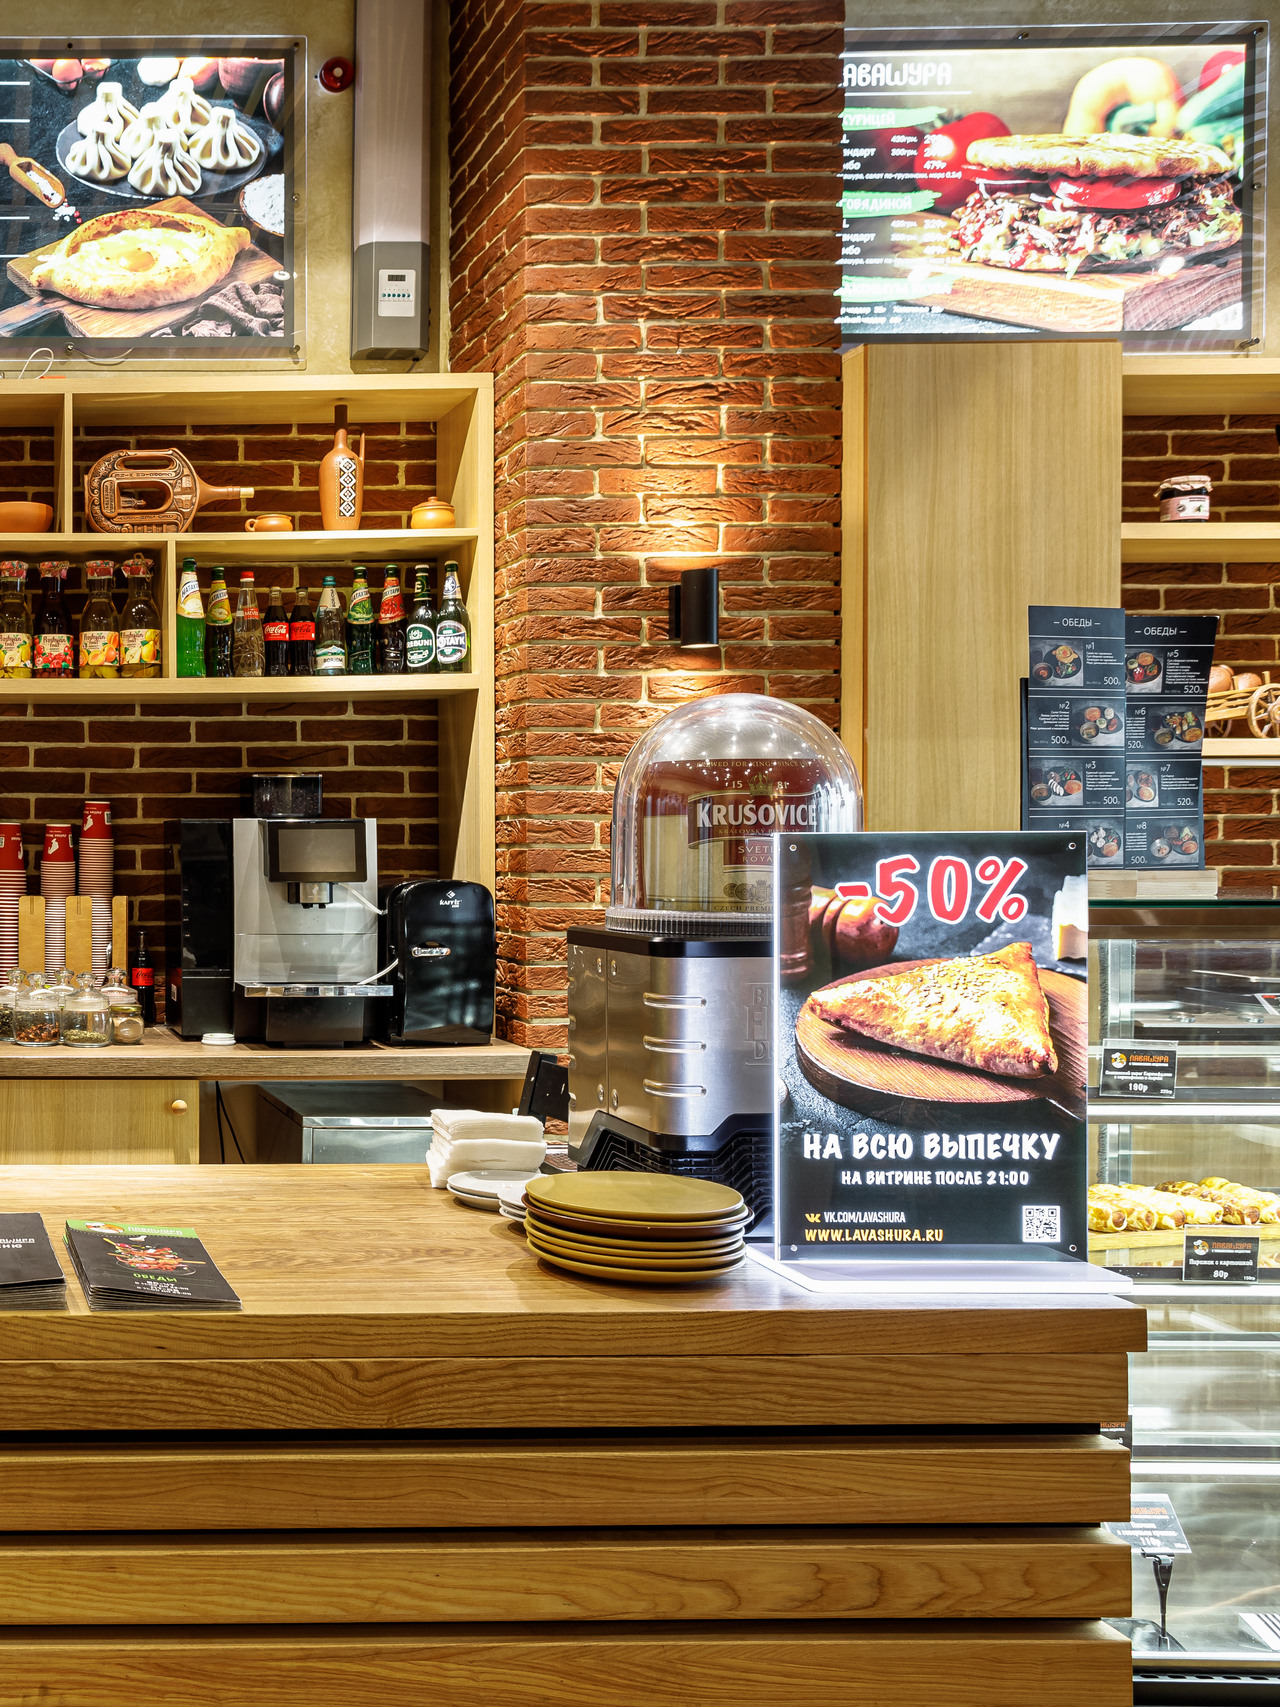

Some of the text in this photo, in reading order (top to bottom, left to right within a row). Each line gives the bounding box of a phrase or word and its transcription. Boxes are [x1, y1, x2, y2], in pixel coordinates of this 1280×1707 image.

[842, 62, 952, 87] АВАШУРА
[1062, 618, 1092, 627] ОБЕДЫ
[1144, 627, 1177, 636] ОБЕДЫ
[732, 781, 788, 789] 15 81
[696, 800, 818, 828] KRUŠOVICE
[742, 855, 773, 863] ROYA
[834, 854, 1029, 927] -50%
[1129, 1055, 1169, 1063] ЛАВАШУРА
[803, 1133, 1060, 1160] НА ВСЮ ВЫПЕЧКУ
[841, 1171, 1028, 1185] НА ВИТРИНЕ ПОСЛЕ 21:00
[824, 1212, 906, 1224] VK.COM/LAVASHURA
[805, 1228, 944, 1242] WWW.LAVASHURA.RU
[133, 1273, 178, 1282] ОБЕДЫ
[1213, 1270, 1228, 1279] 80р
